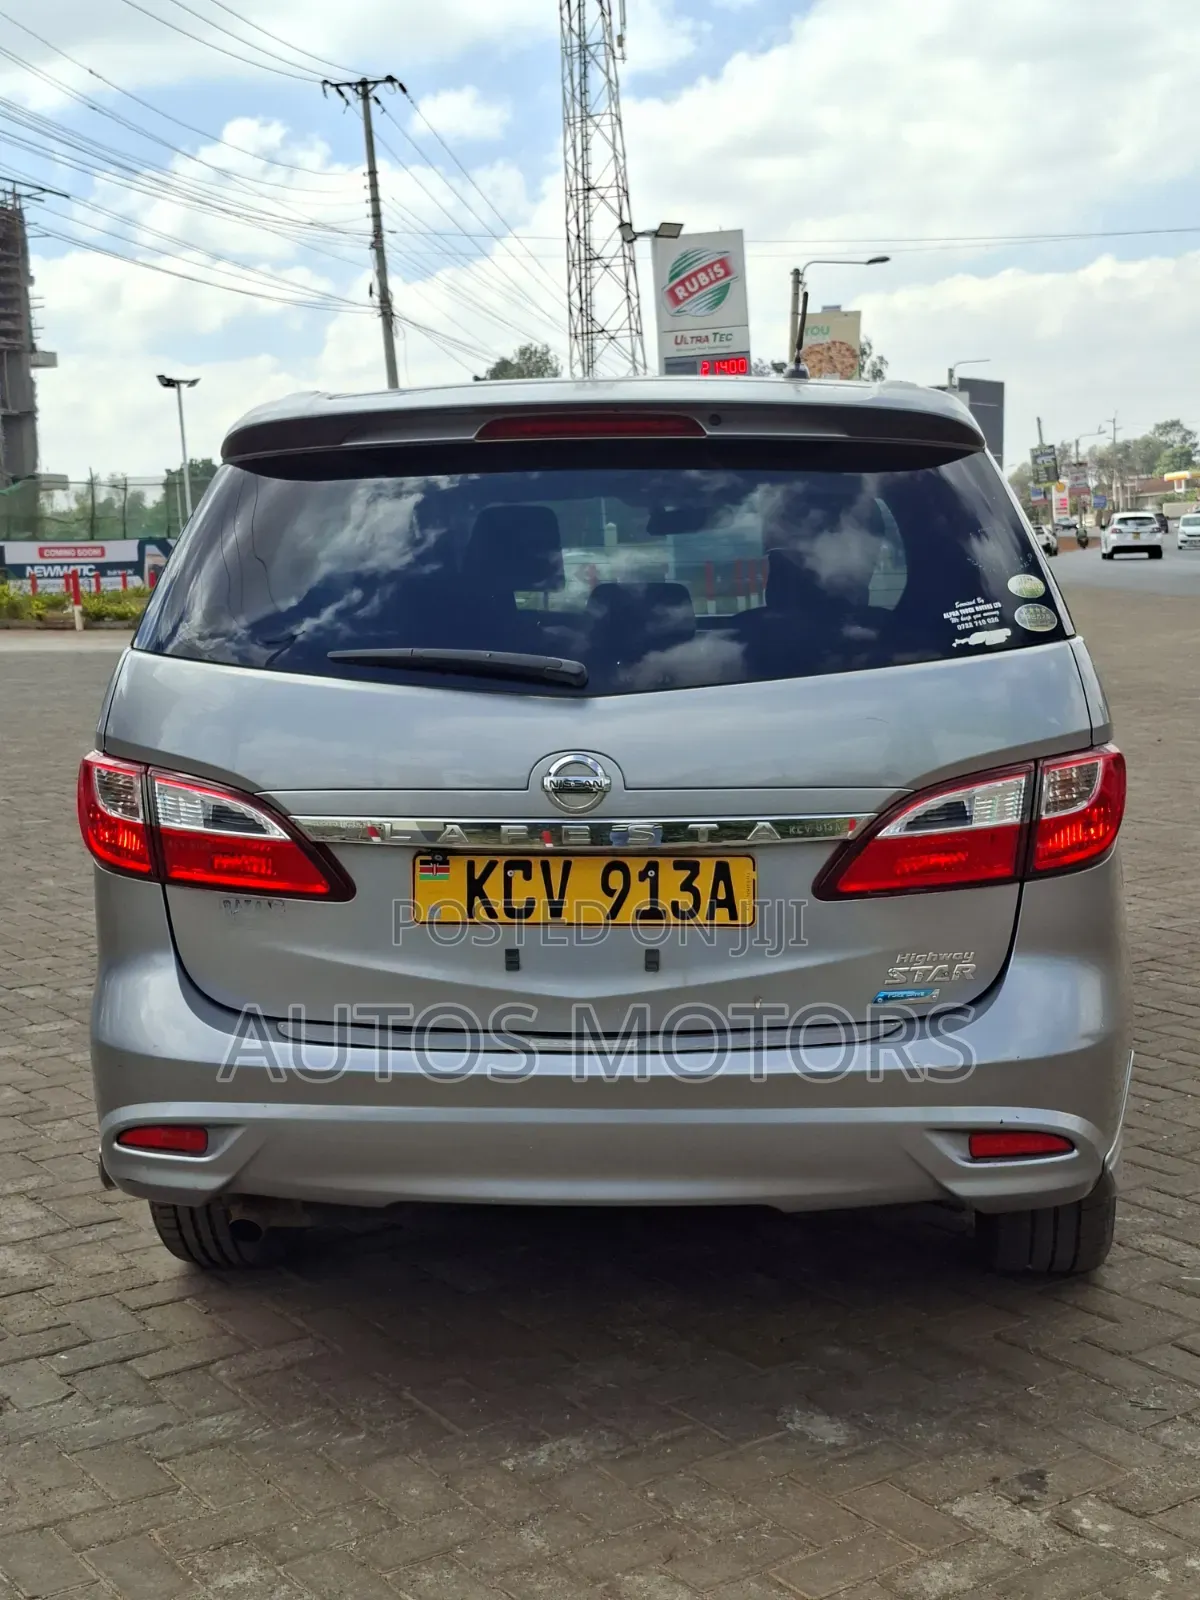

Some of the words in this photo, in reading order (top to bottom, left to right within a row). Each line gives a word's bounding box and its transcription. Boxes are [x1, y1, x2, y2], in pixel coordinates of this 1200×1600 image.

[674, 334, 710, 346] ULTRA
[712, 331, 733, 342] TEC
[549, 780, 603, 790] NISSAN
[466, 859, 572, 920] KCV
[600, 859, 739, 920] 913A
[896, 951, 975, 966] Highway
[884, 963, 977, 985] STAR
